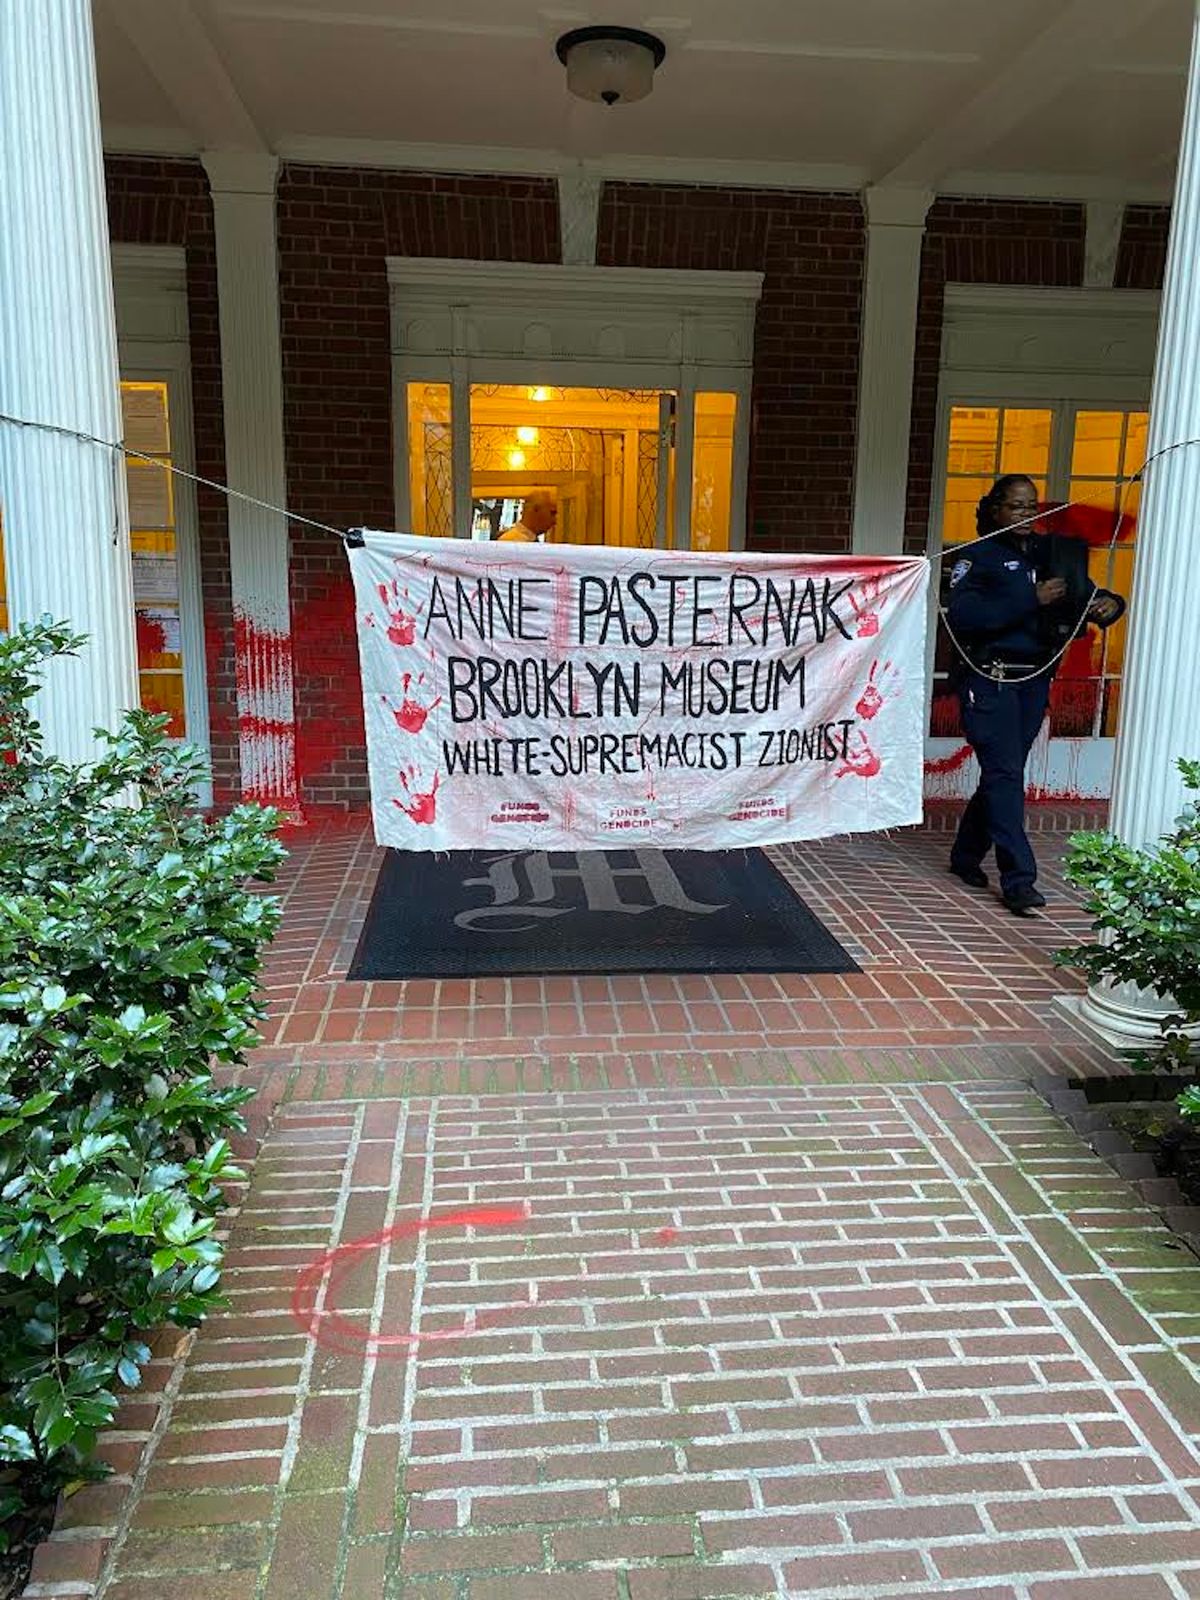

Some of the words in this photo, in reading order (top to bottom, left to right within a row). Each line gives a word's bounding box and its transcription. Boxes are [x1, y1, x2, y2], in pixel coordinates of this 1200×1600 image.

[423, 574, 551, 642] ANNE
[578, 572, 854, 648] PASTERNAK
[447, 655, 641, 724] BROOKLYN
[659, 656, 806, 717] MUSEUM
[442, 730, 748, 778] WHITE-SUPREMACIST
[757, 718, 856, 768] ZIONIST
